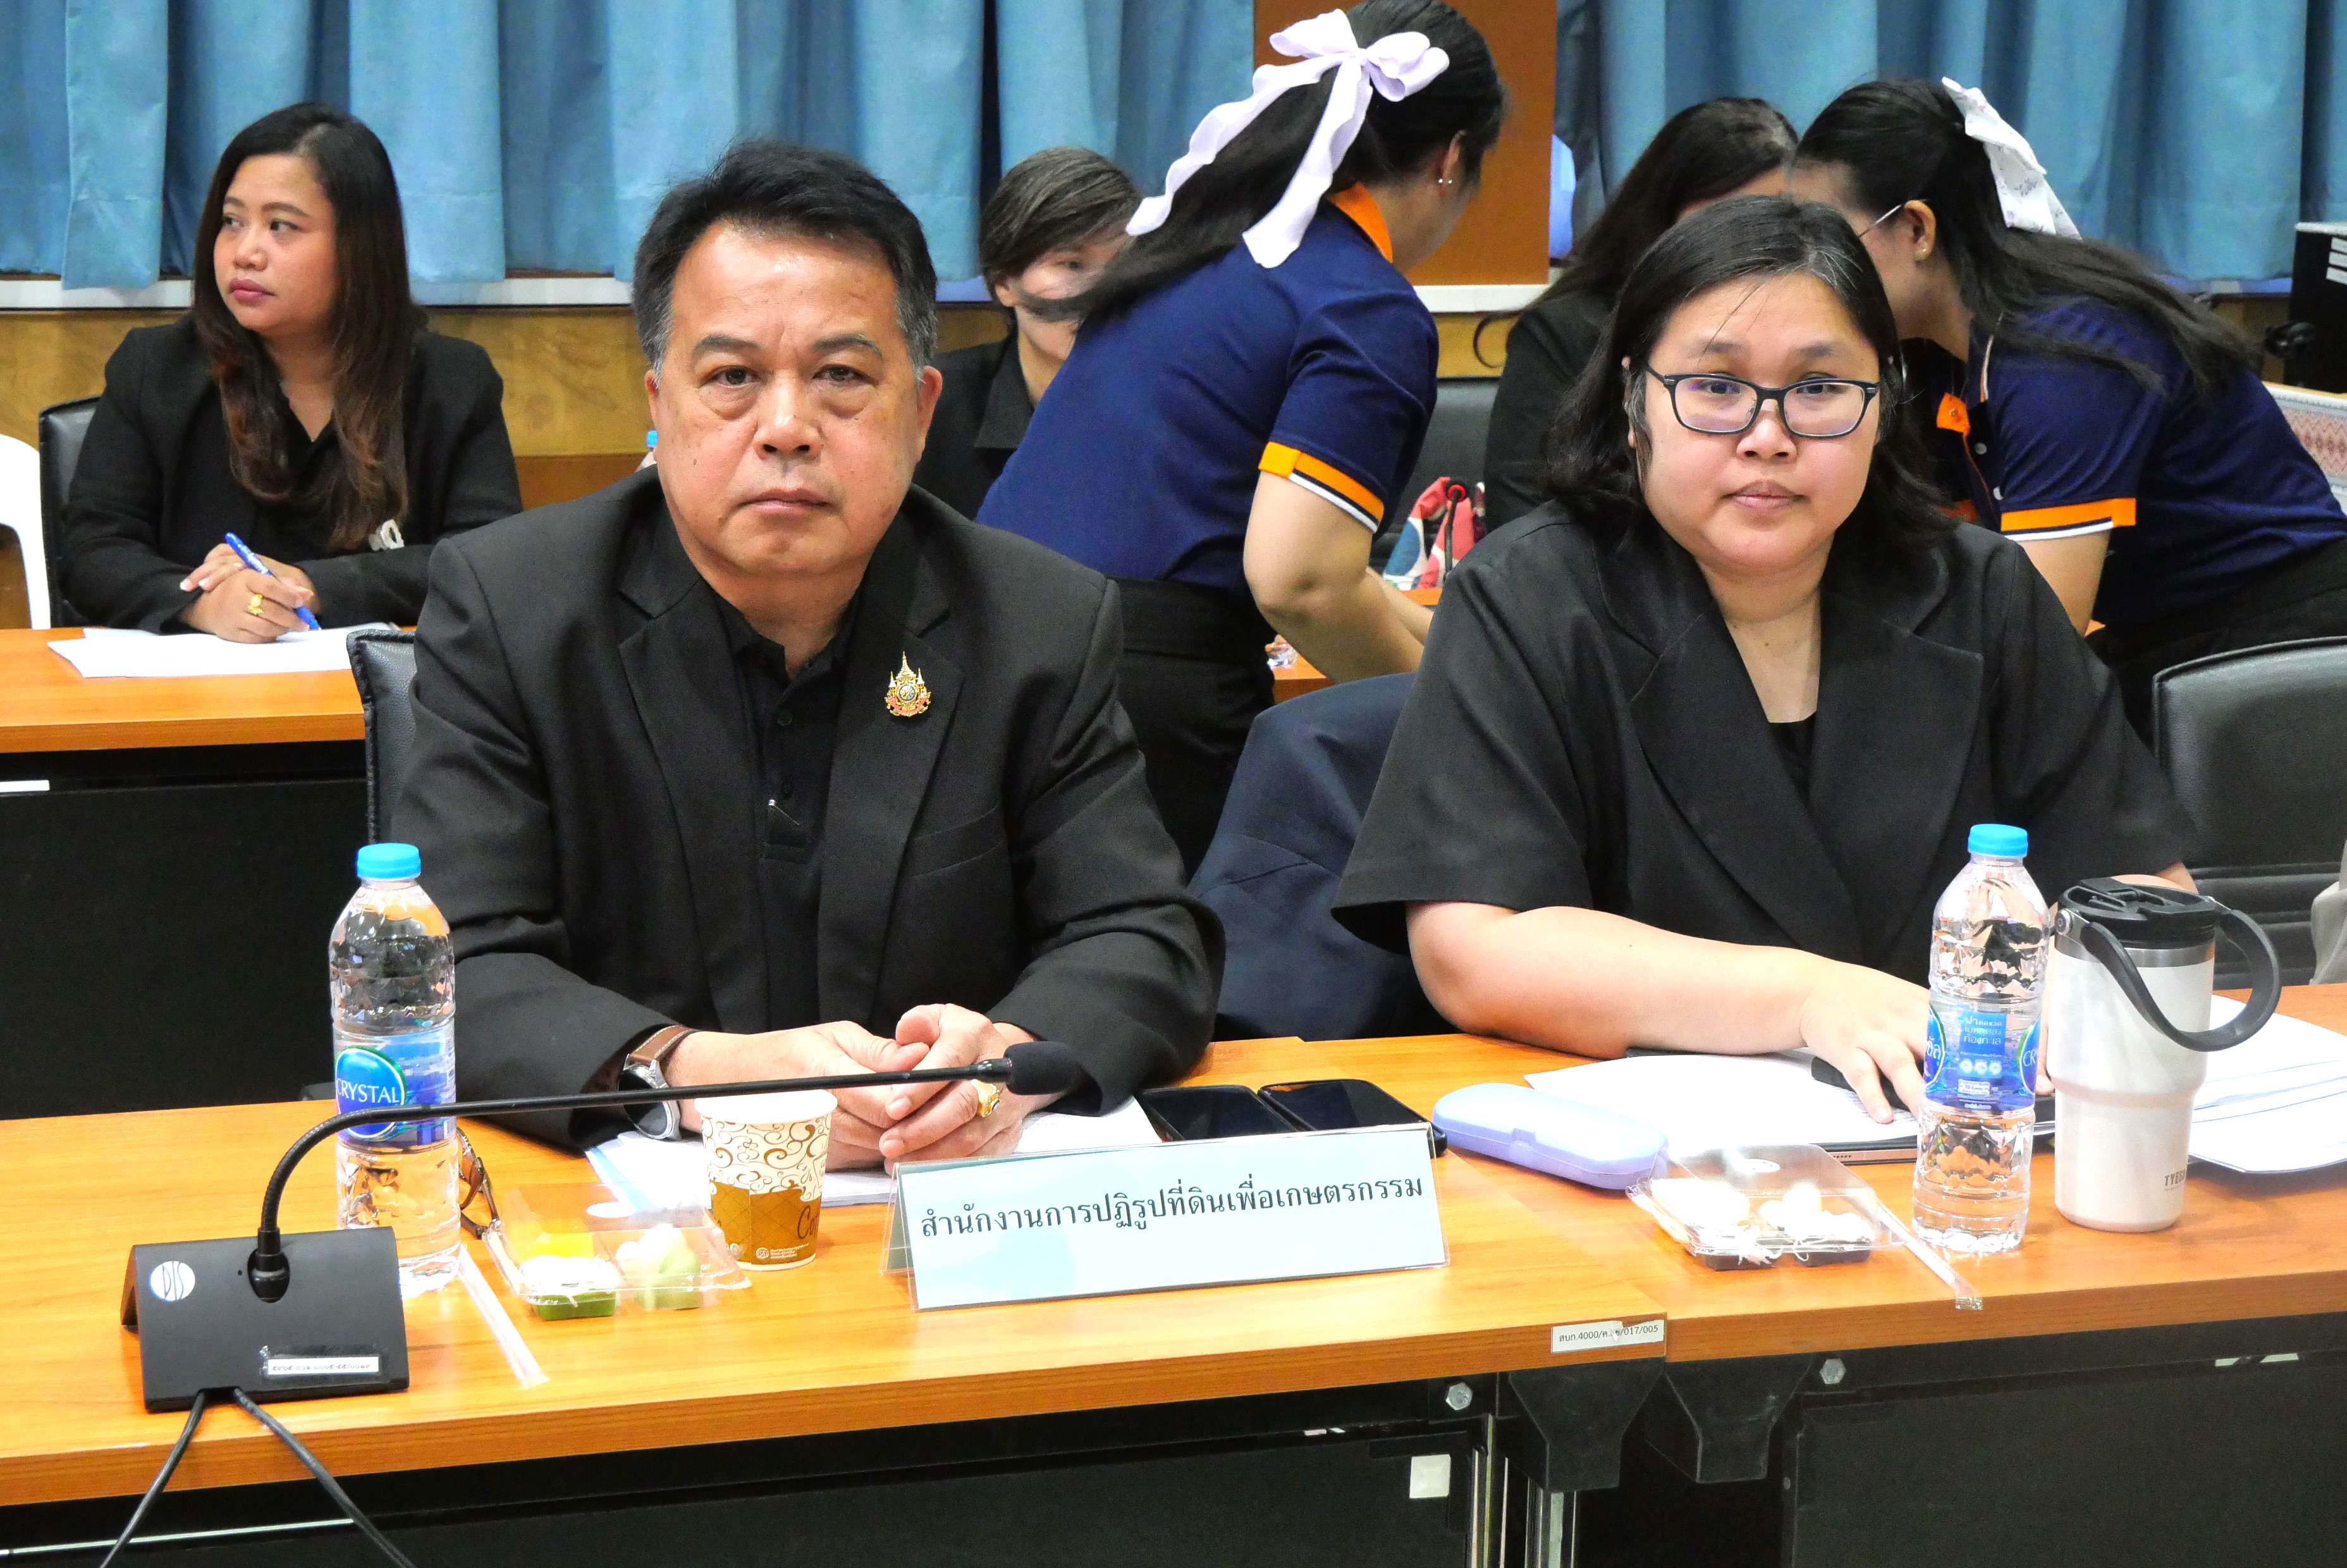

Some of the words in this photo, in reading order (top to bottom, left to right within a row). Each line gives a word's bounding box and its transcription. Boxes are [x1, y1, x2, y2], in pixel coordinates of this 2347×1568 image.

[336, 1077, 400, 1103] CRYSTAL
[921, 1173, 1423, 1237] สำนักงานการปฏิรูปที่ดินเพื่อเกษตรกรรม
